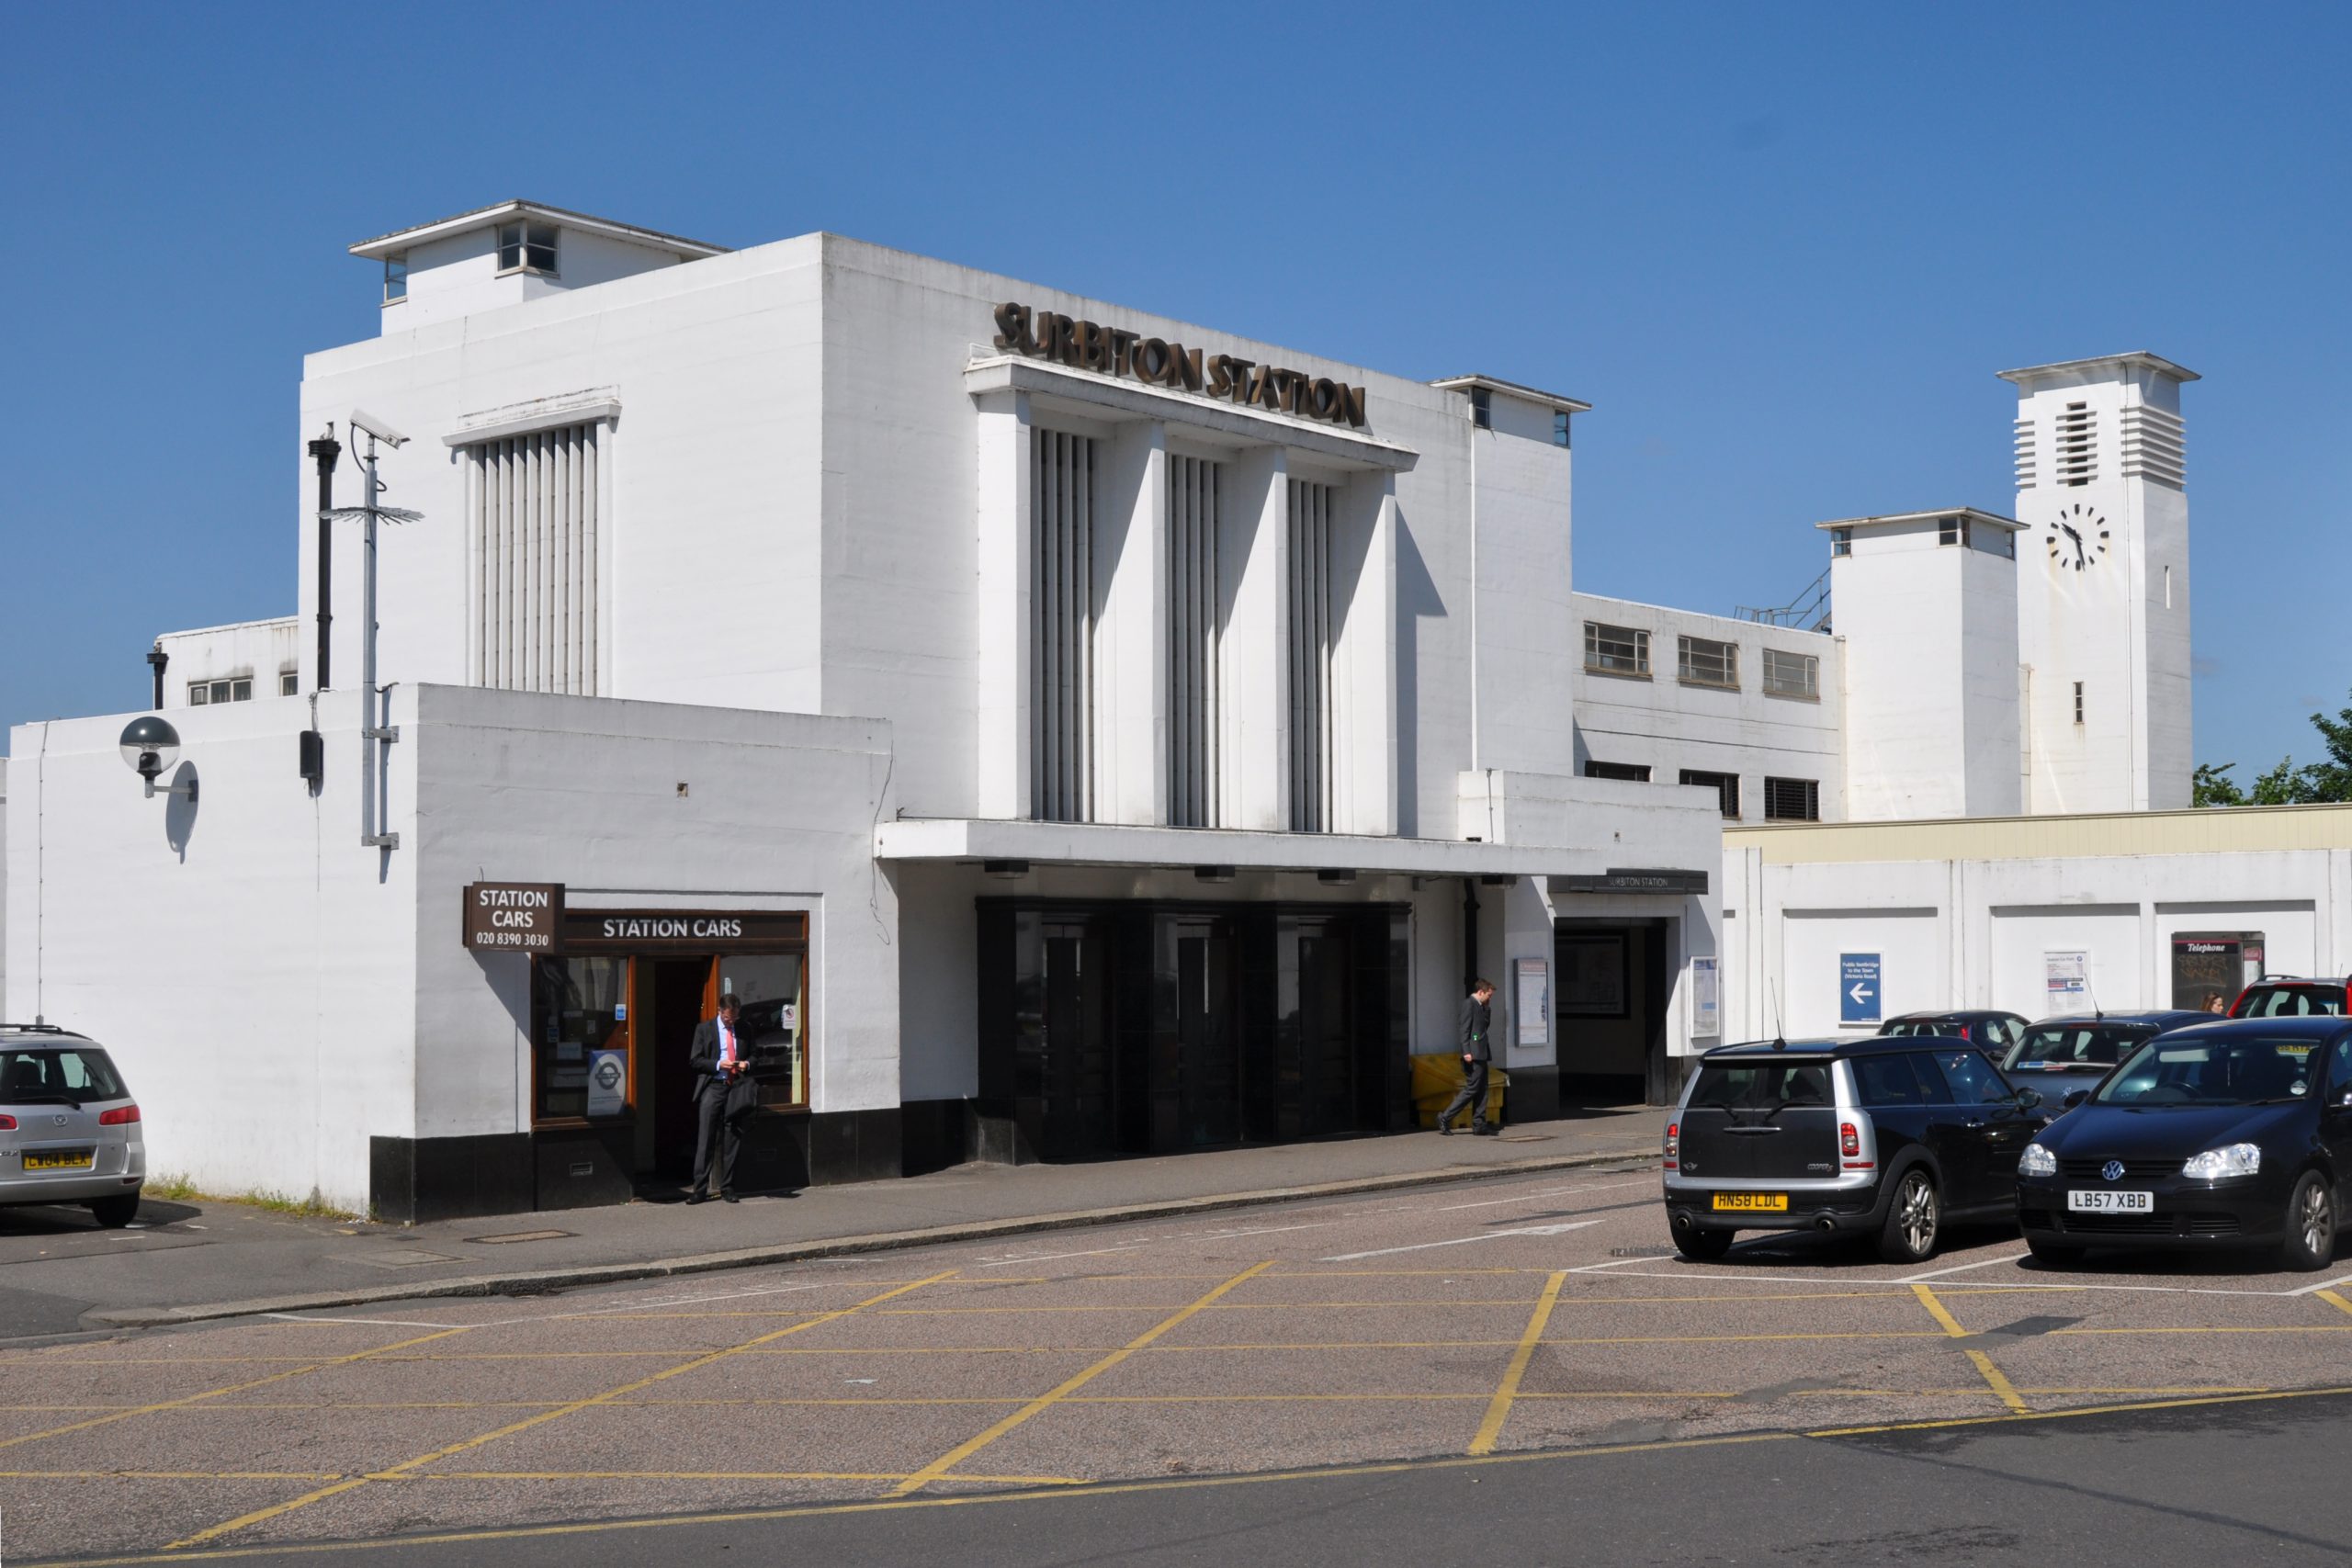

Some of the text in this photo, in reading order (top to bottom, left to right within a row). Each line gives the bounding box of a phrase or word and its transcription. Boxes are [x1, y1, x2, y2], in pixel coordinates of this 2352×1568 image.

[994, 301, 1365, 426] SURBITON STATION
[1610, 876, 1668, 887] SURBITON STATION
[480, 889, 548, 908] STATION
[492, 910, 534, 928] CARS
[604, 919, 741, 937] STATION CARS
[477, 932, 548, 946] 020 8390 3030
[2188, 942, 2225, 953] Telephone
[1718, 1193, 1781, 1207] HN58 LDL
[2075, 1192, 2146, 1208] LB57 XBD
